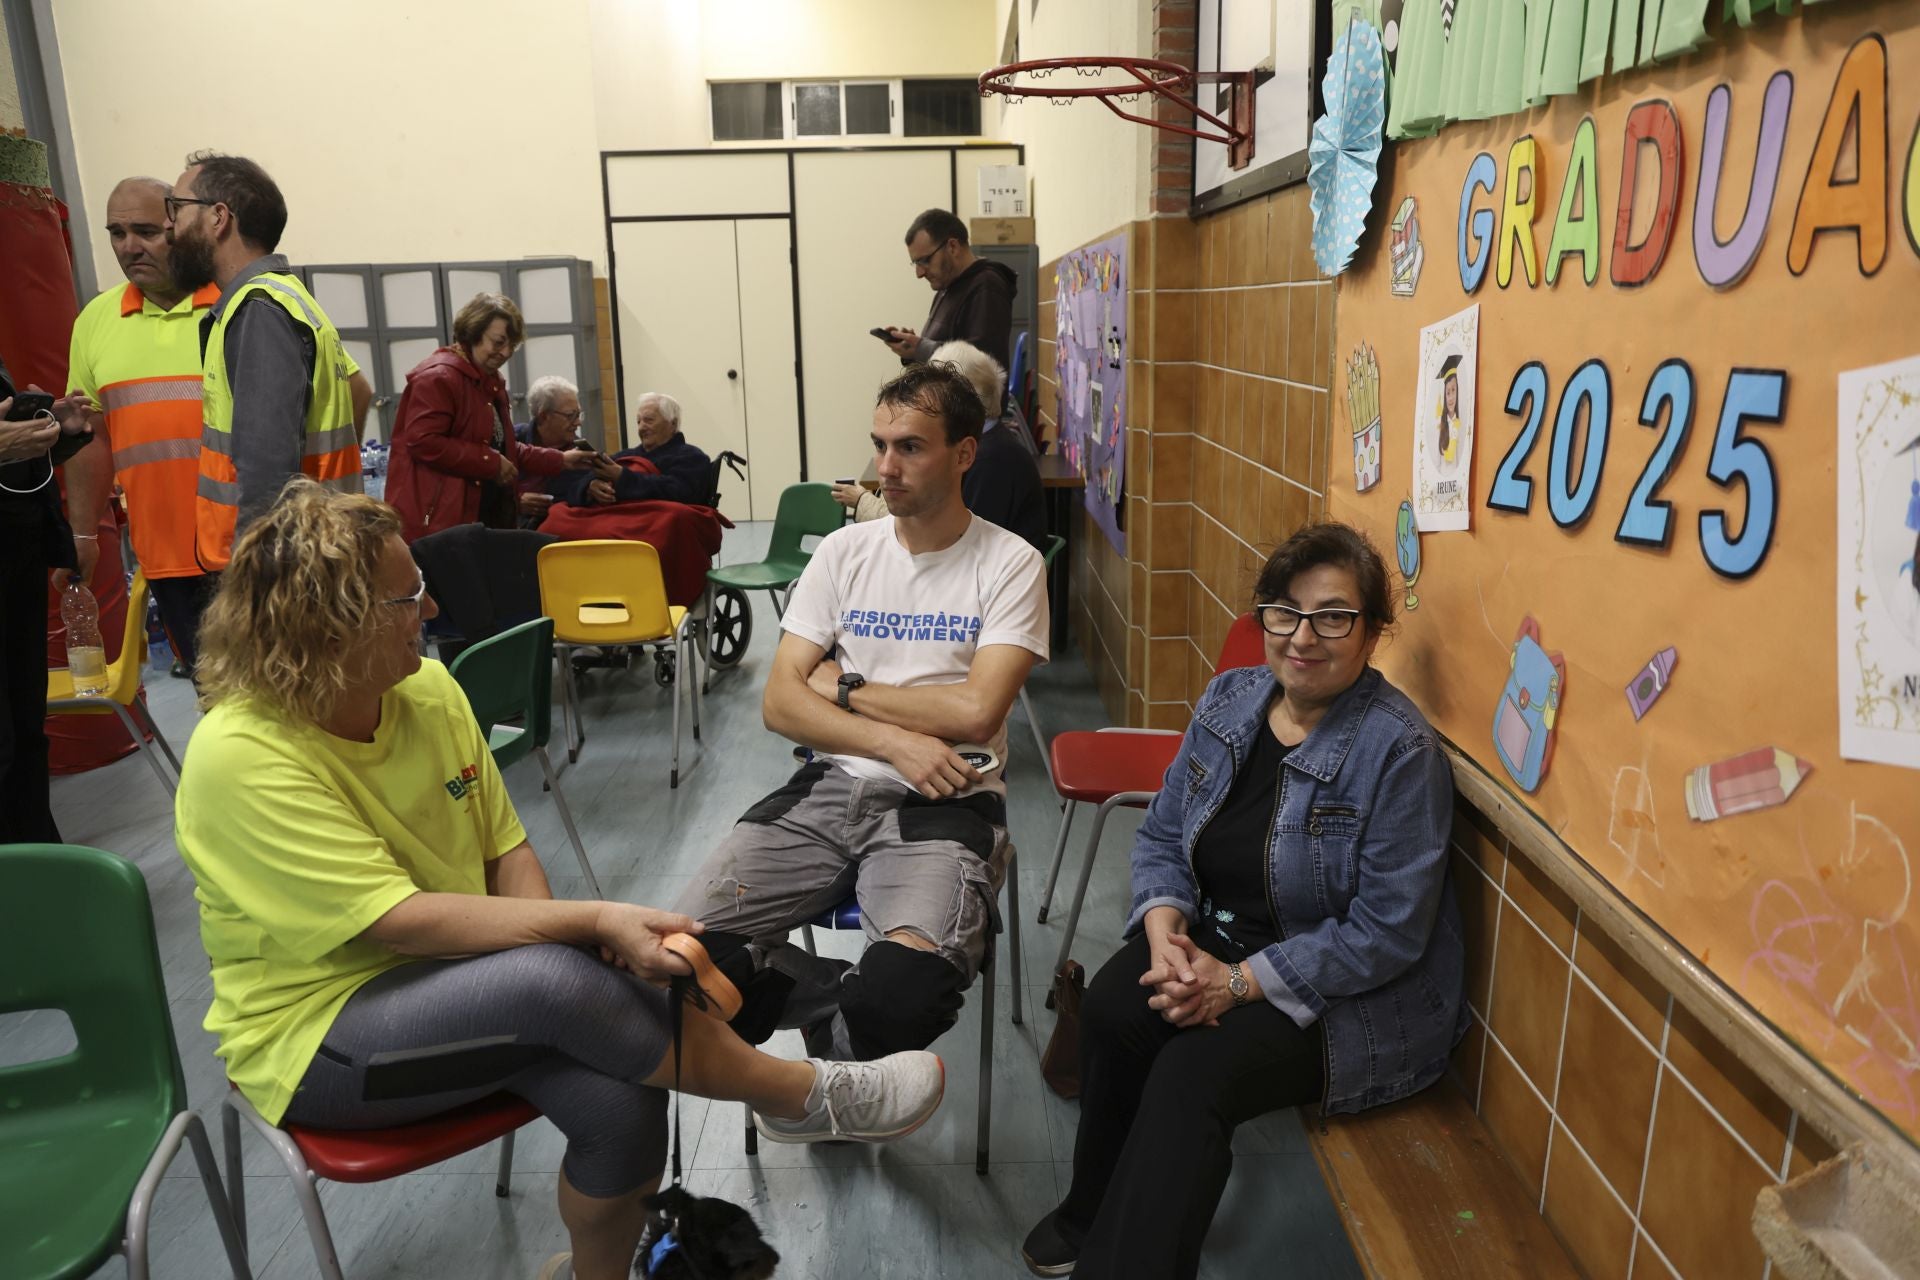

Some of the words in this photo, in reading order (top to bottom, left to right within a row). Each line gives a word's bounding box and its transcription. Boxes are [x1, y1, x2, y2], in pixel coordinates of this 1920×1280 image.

[1457, 31, 1920, 295] GRADUA
[1487, 357, 1788, 580] 2025
[1437, 480, 1457, 495] IRUNE
[849, 609, 981, 630] FISIOTERÀPIA
[854, 624, 978, 643] MOVIMENT
[1903, 675, 1920, 698] N
